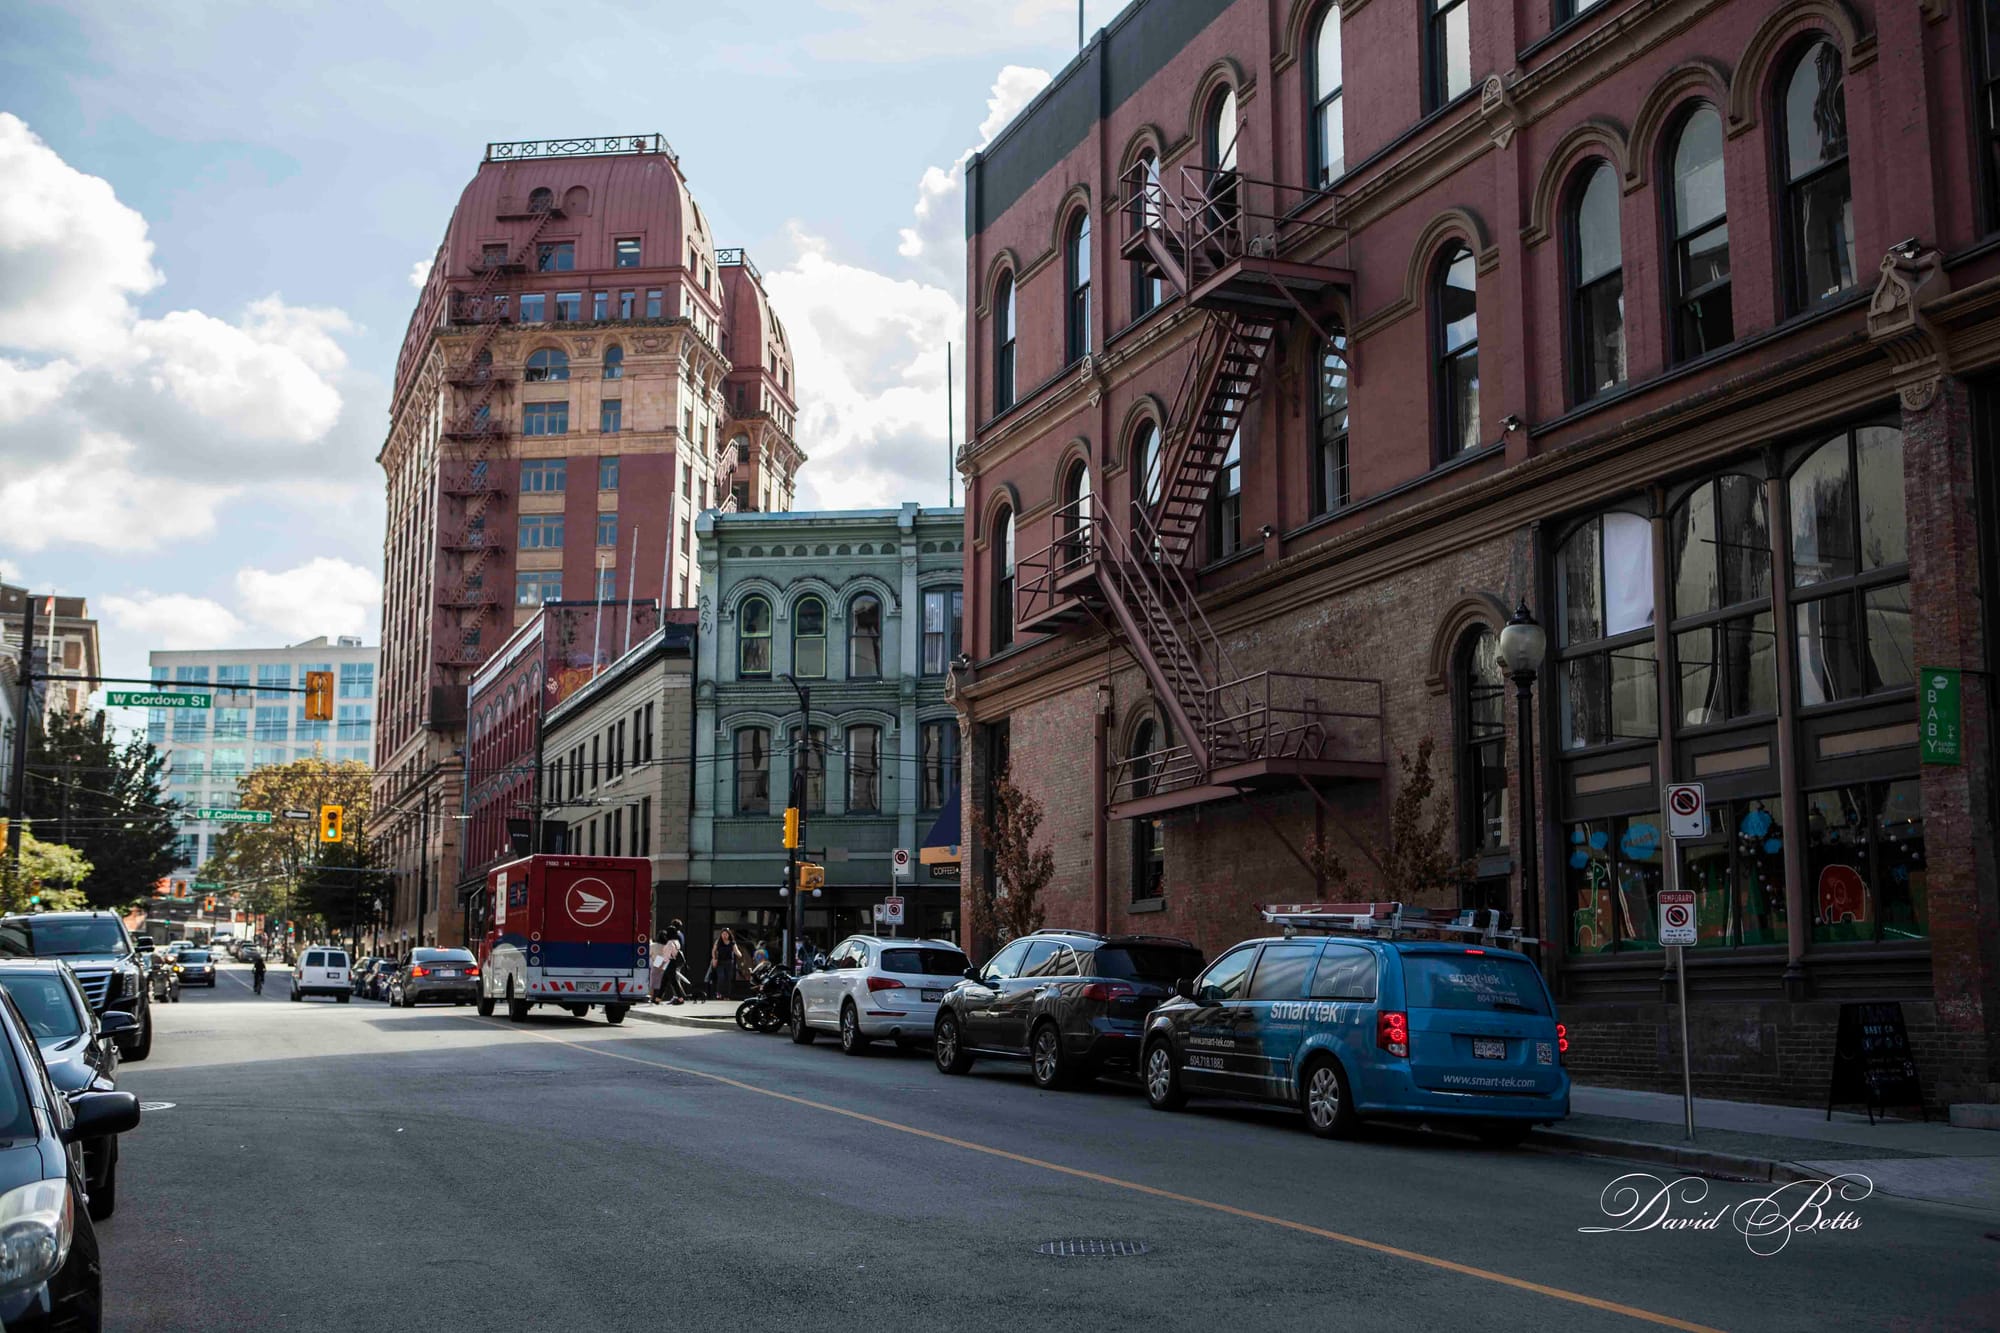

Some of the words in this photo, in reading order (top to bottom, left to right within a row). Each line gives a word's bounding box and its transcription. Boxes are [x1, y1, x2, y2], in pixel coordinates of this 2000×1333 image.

[112, 694, 126, 704] W
[131, 694, 186, 706] Cordova
[191, 695, 205, 707] St
[1927, 689, 1939, 753] BABY
[202, 810, 211, 818] W
[256, 813, 267, 821] St
[1661, 894, 1692, 903] TEMPORARY
[1189, 1036, 1235, 1048] www.smart-tek.com
[1189, 1055, 1225, 1069] 604.718.1882
[1443, 1074, 1536, 1088] www.smart-tek.com
